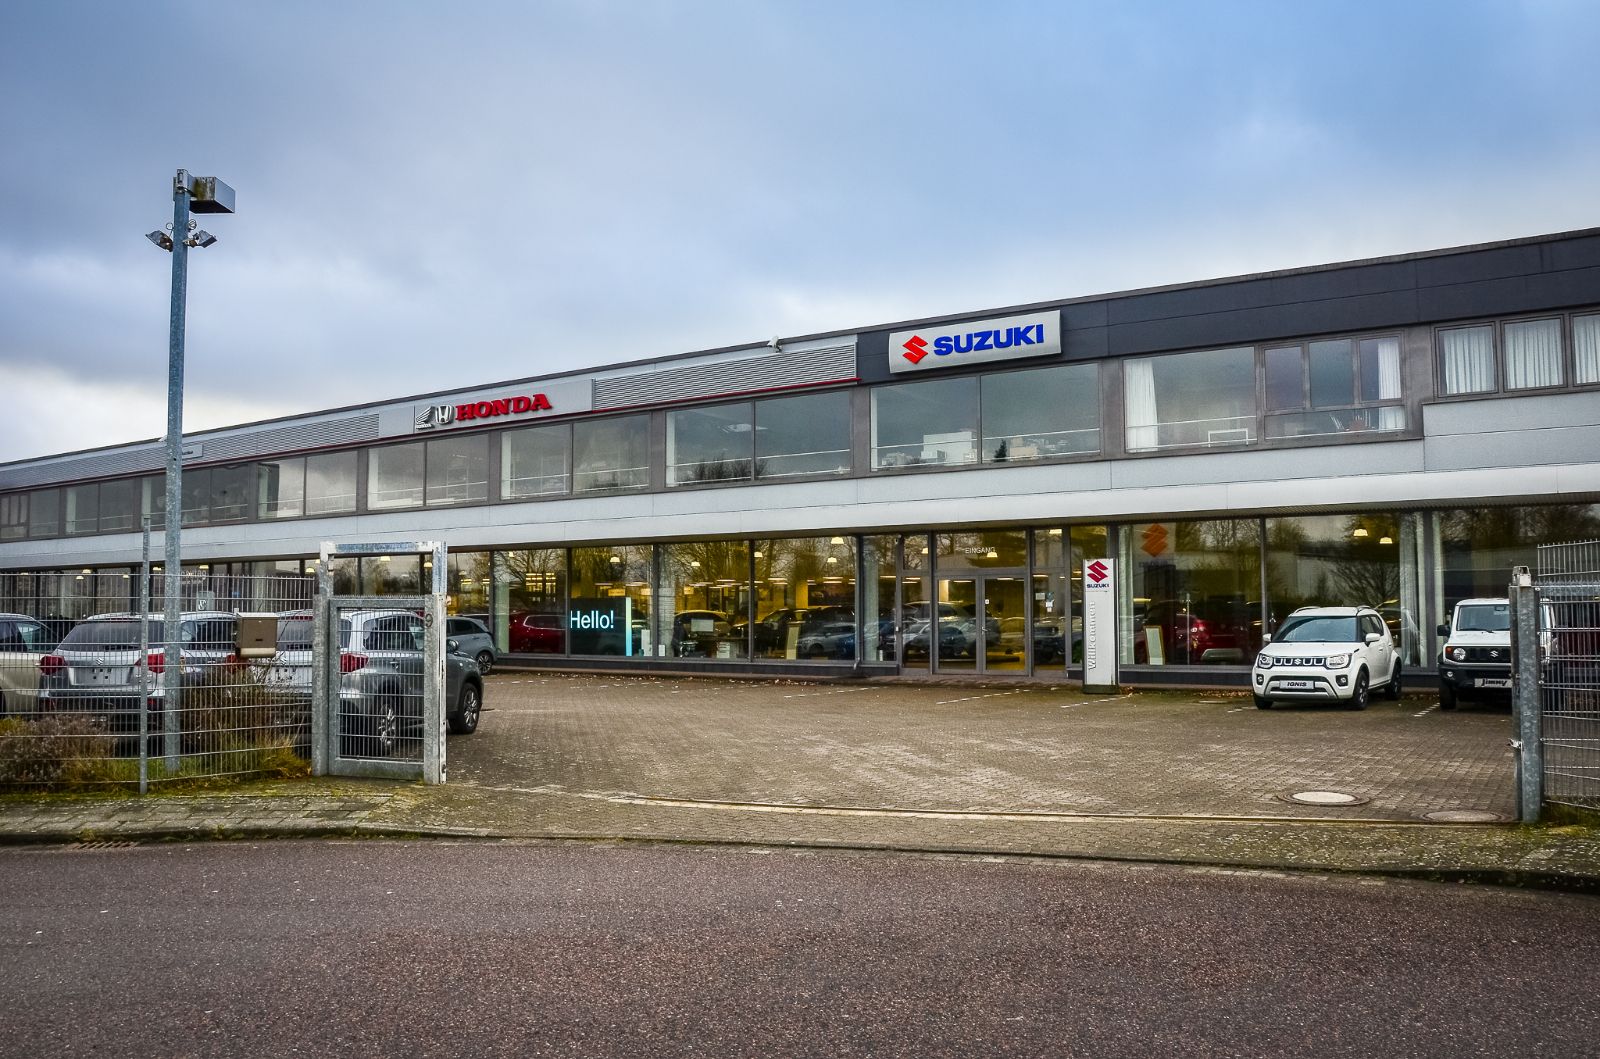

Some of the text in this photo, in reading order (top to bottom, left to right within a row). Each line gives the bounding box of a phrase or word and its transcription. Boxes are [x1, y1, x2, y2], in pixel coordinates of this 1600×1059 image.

[933, 324, 1044, 356] SUZUKI
[455, 393, 553, 421] HONDA
[570, 610, 614, 629] Hello!
